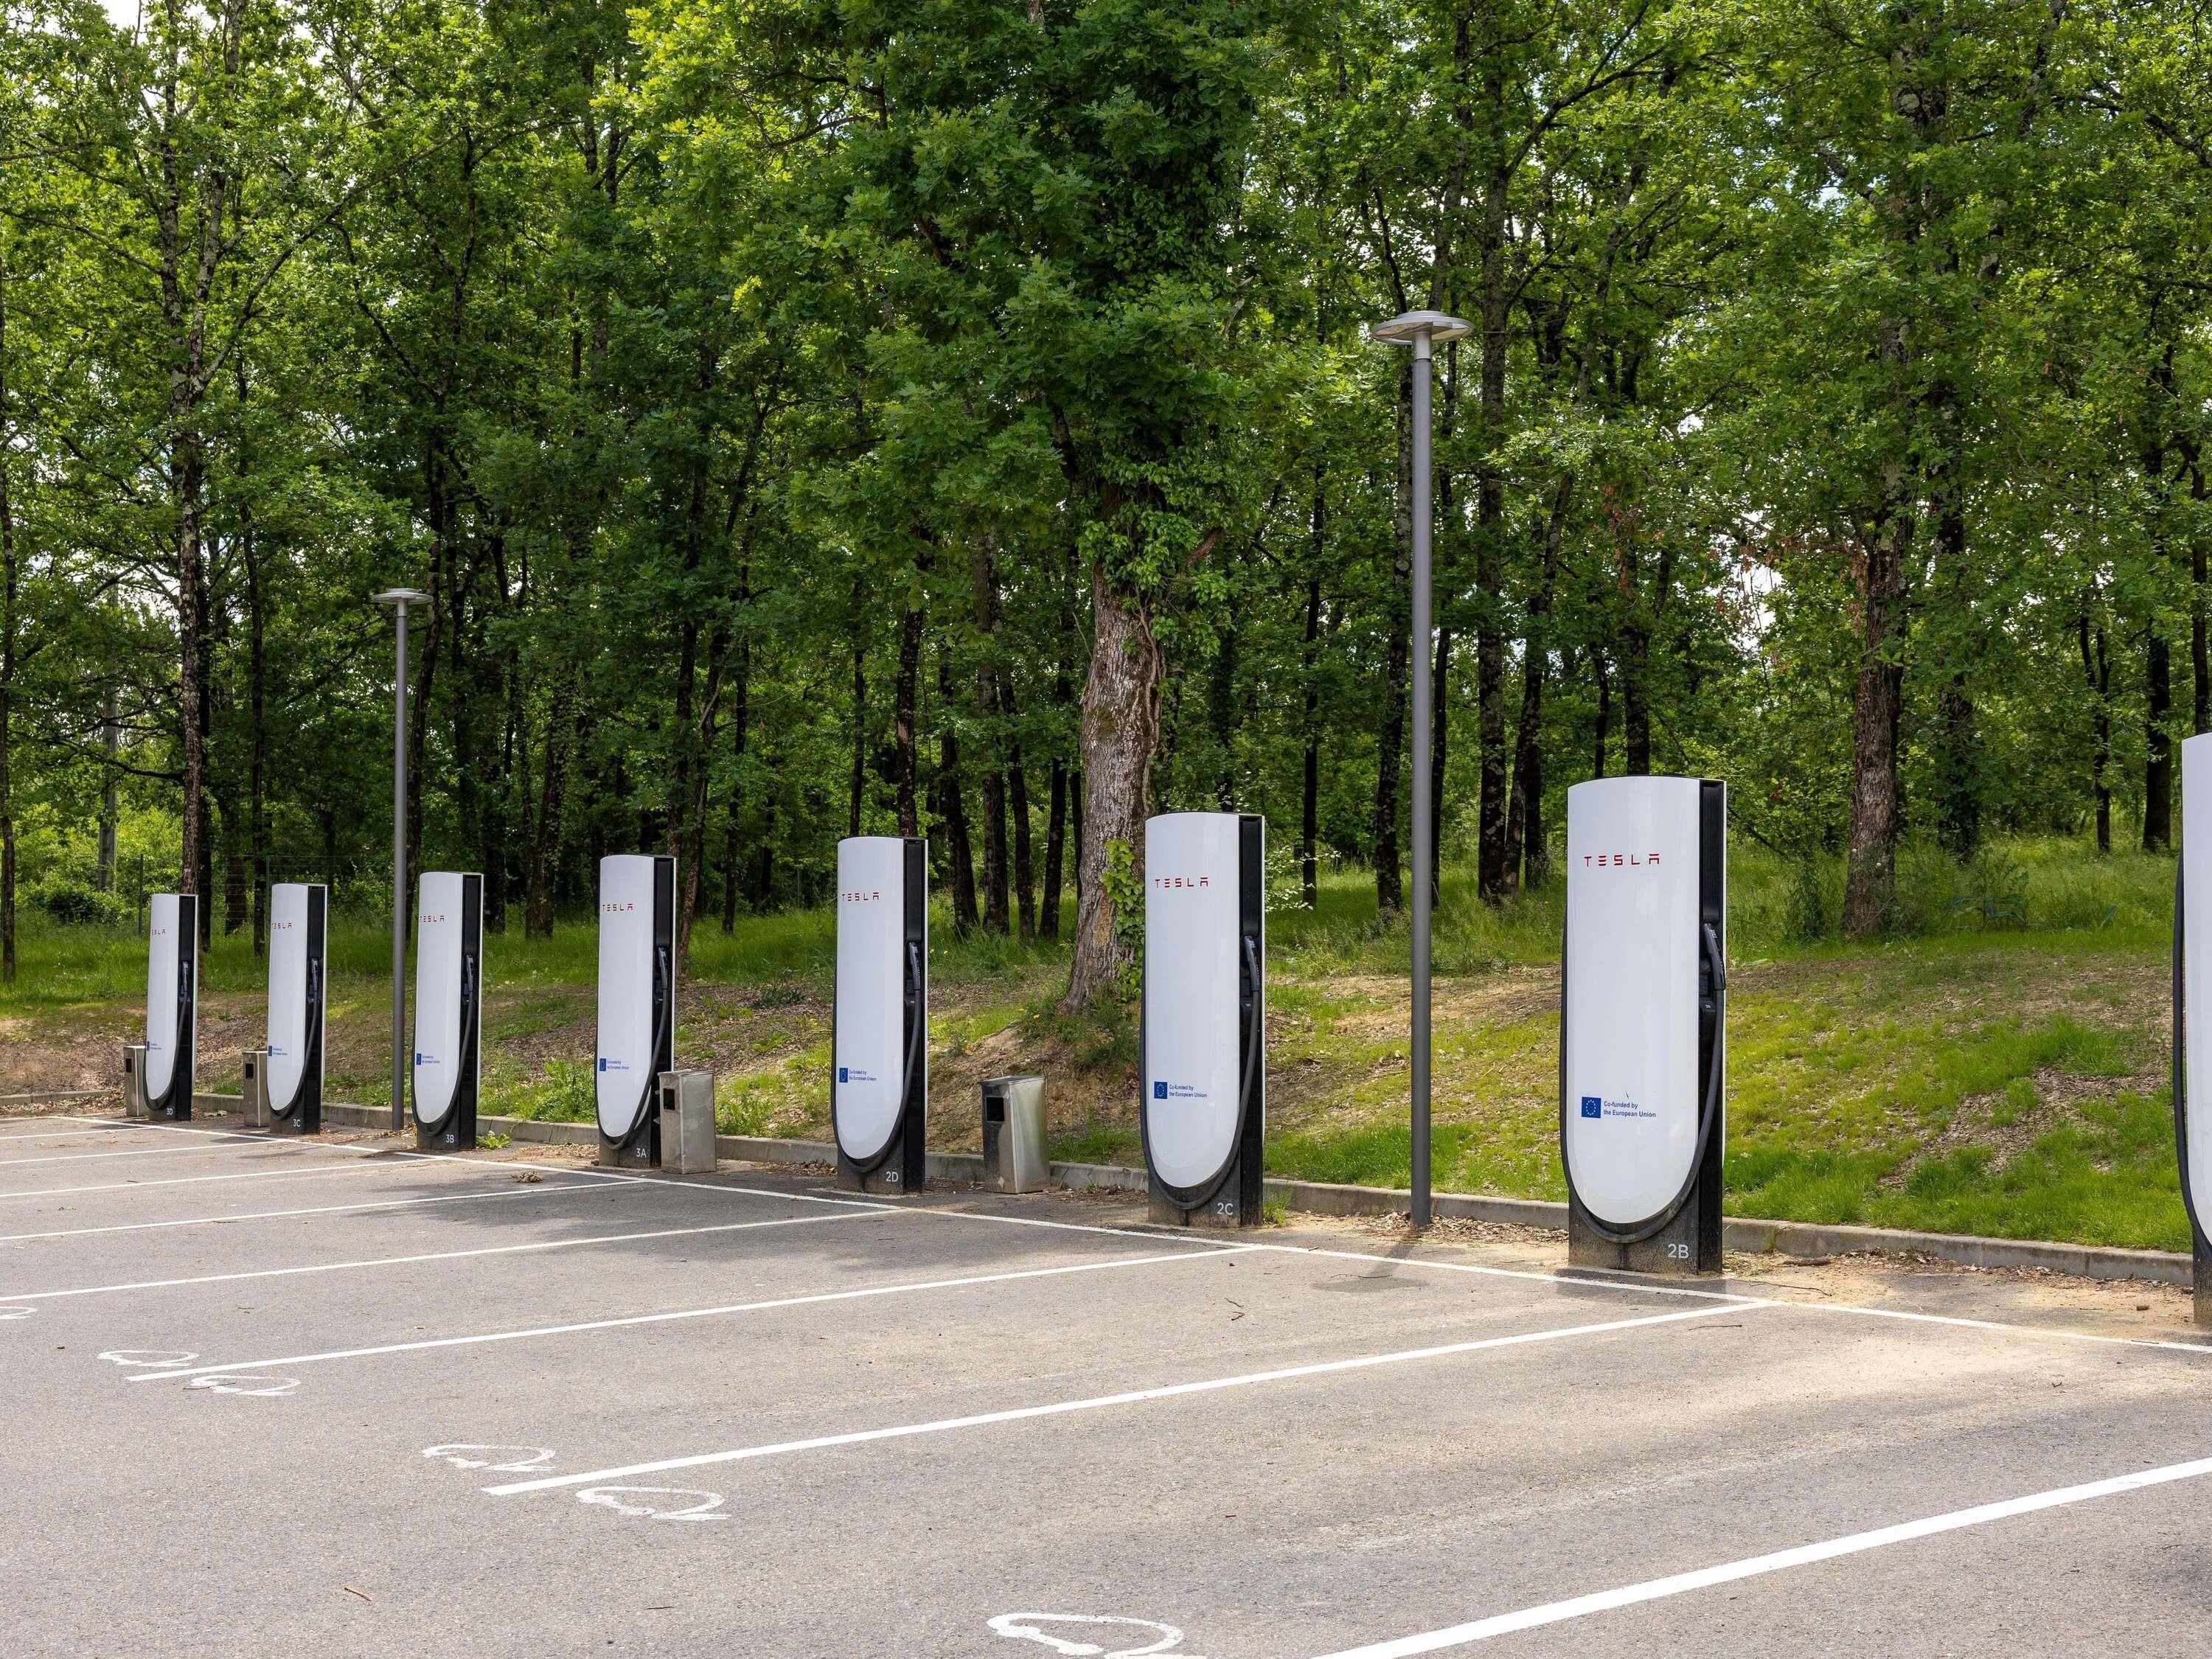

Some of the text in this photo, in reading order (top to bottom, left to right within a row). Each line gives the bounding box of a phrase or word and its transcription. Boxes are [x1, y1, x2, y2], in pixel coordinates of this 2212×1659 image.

[1584, 853, 1660, 867] TESLA
[1155, 877, 1208, 888] TESLA
[842, 891, 880, 902] TESLA
[602, 903, 633, 912] TESLA
[1604, 1100, 1630, 1108] Co-funded
[1613, 1110, 1638, 1118] European
[445, 1133, 455, 1144] 3B
[636, 1147, 647, 1158] 3A
[886, 1171, 899, 1183] 2D
[1217, 1202, 1234, 1215] 2C
[1668, 1243, 1689, 1259] 2B
